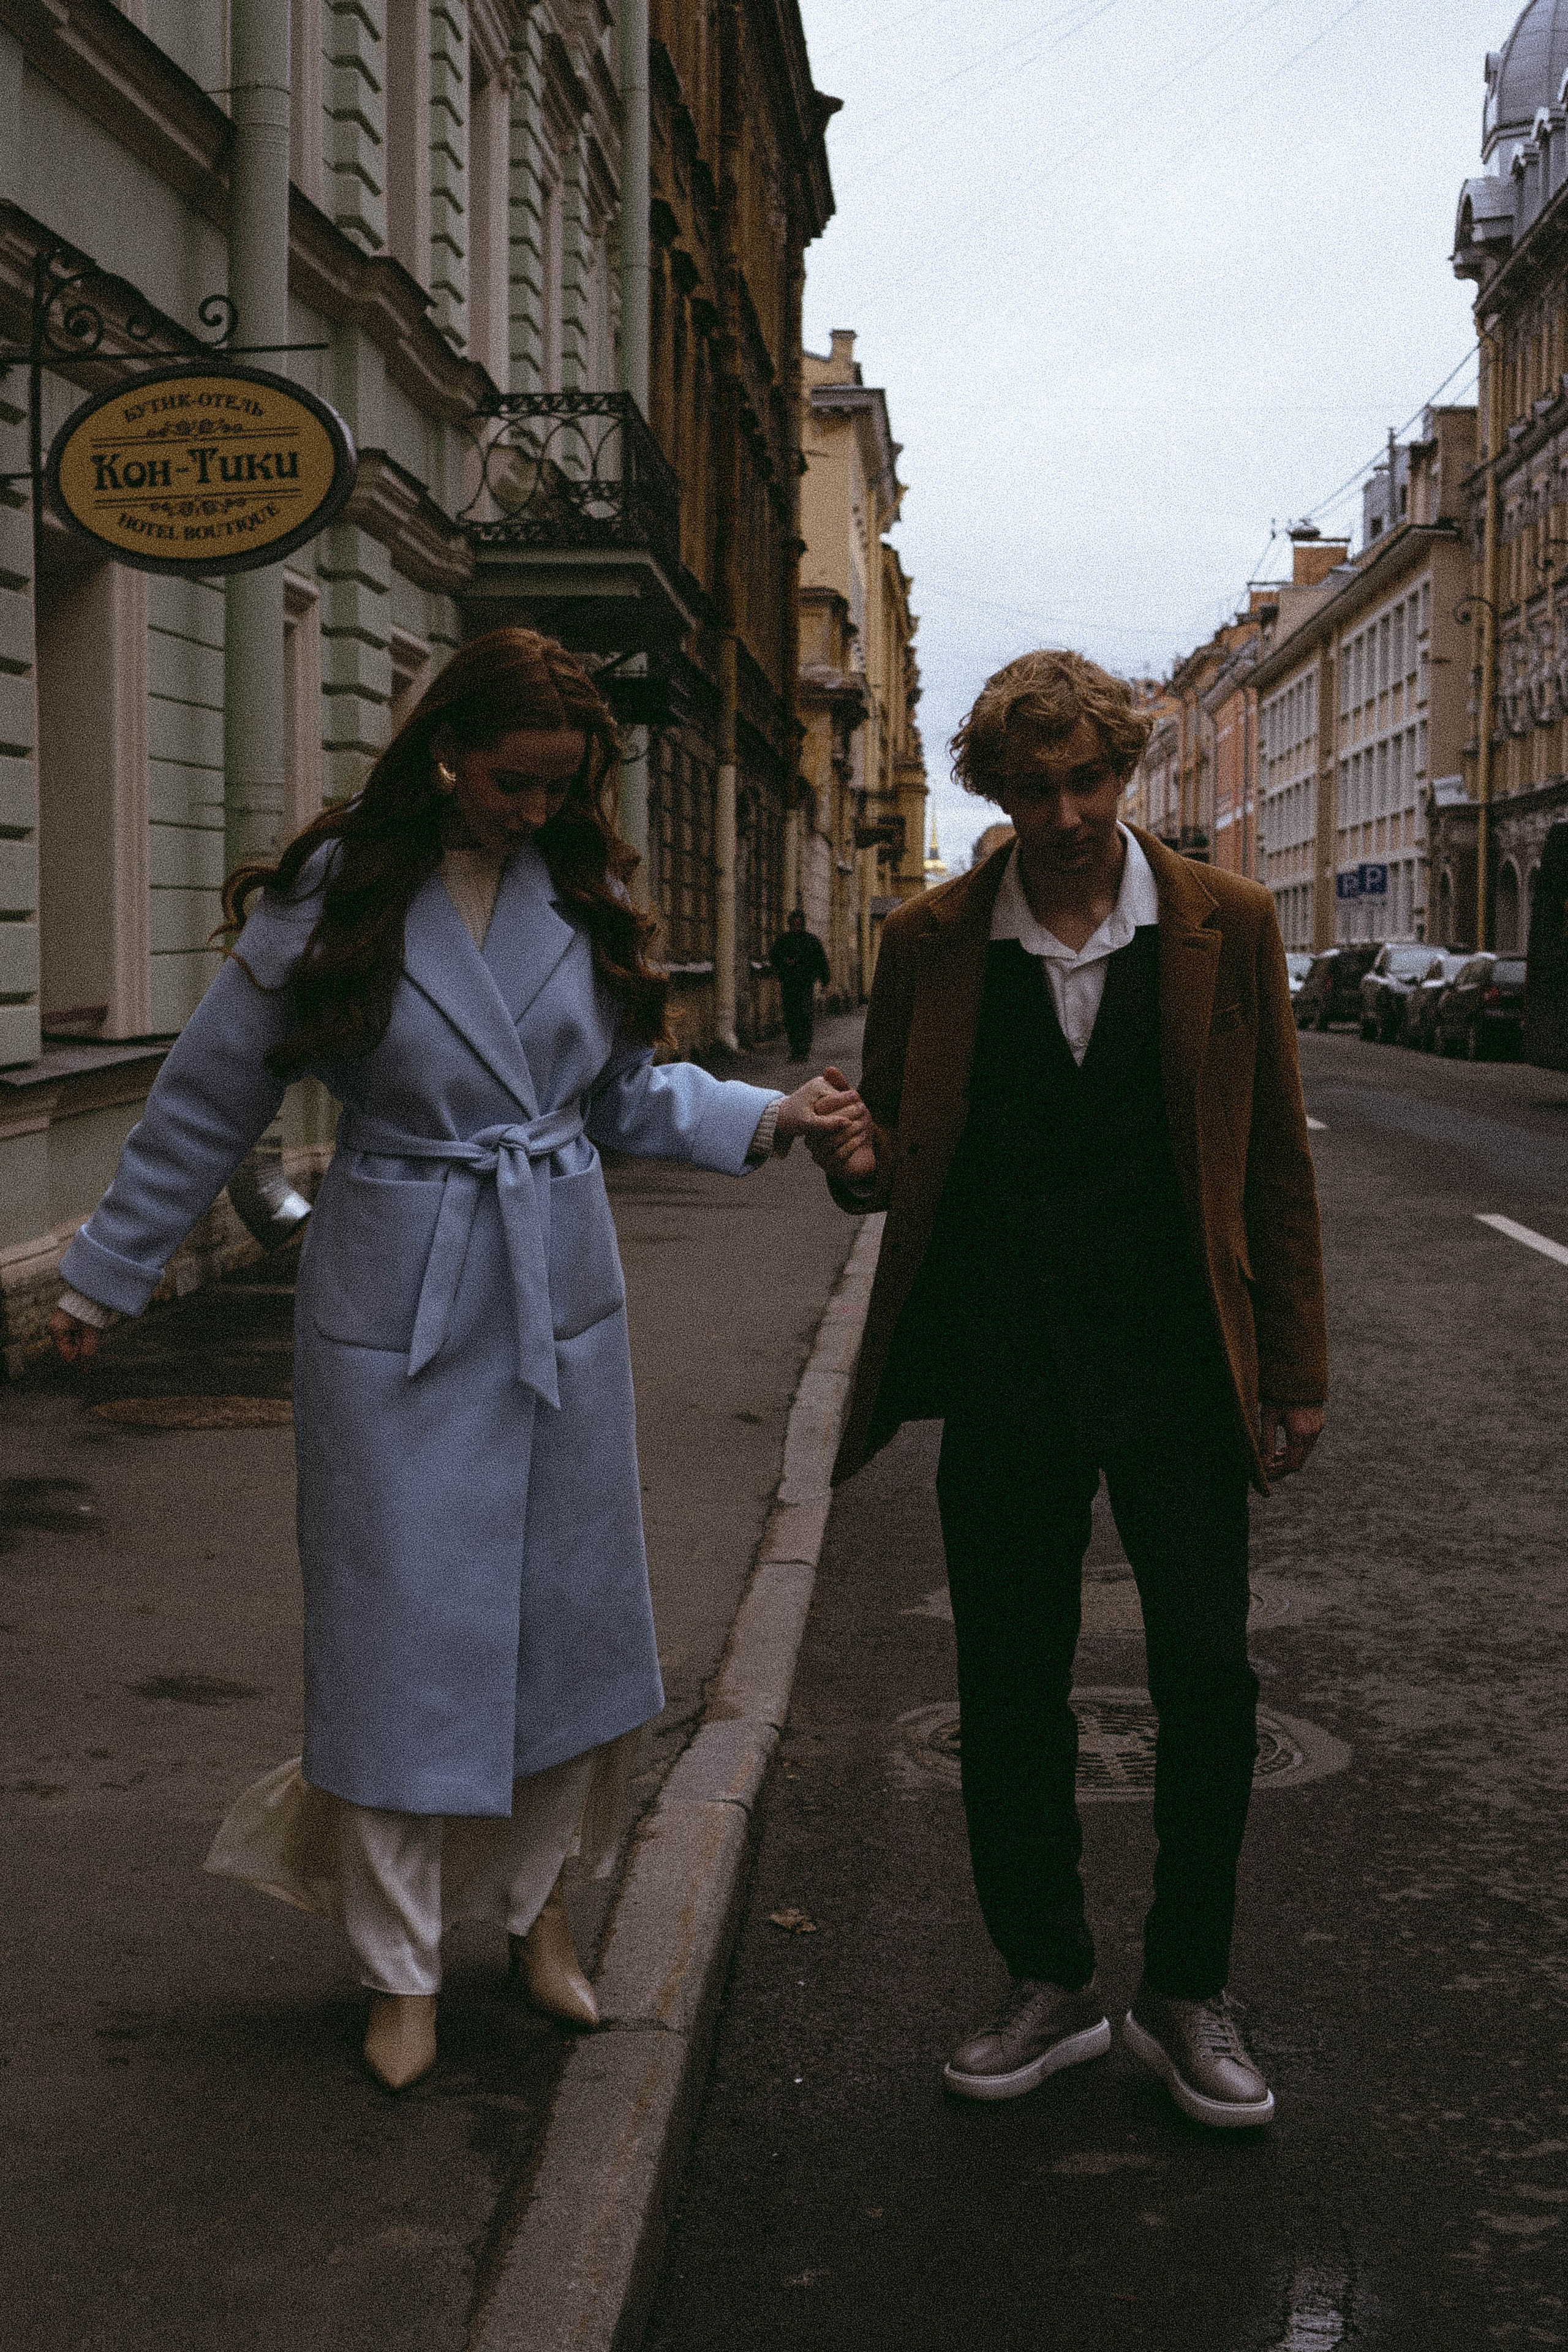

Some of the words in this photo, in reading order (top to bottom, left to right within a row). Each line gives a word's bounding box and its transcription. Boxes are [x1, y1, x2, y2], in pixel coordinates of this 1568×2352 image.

[124, 393, 264, 423] БУТИК-ОТЕЛЬ
[90, 447, 300, 490] Кон-Тики
[118, 513, 178, 540] HOTEL
[184, 504, 280, 540] BOUTIQUE
[1343, 875, 1359, 895] P
[1366, 867, 1382, 890] P
